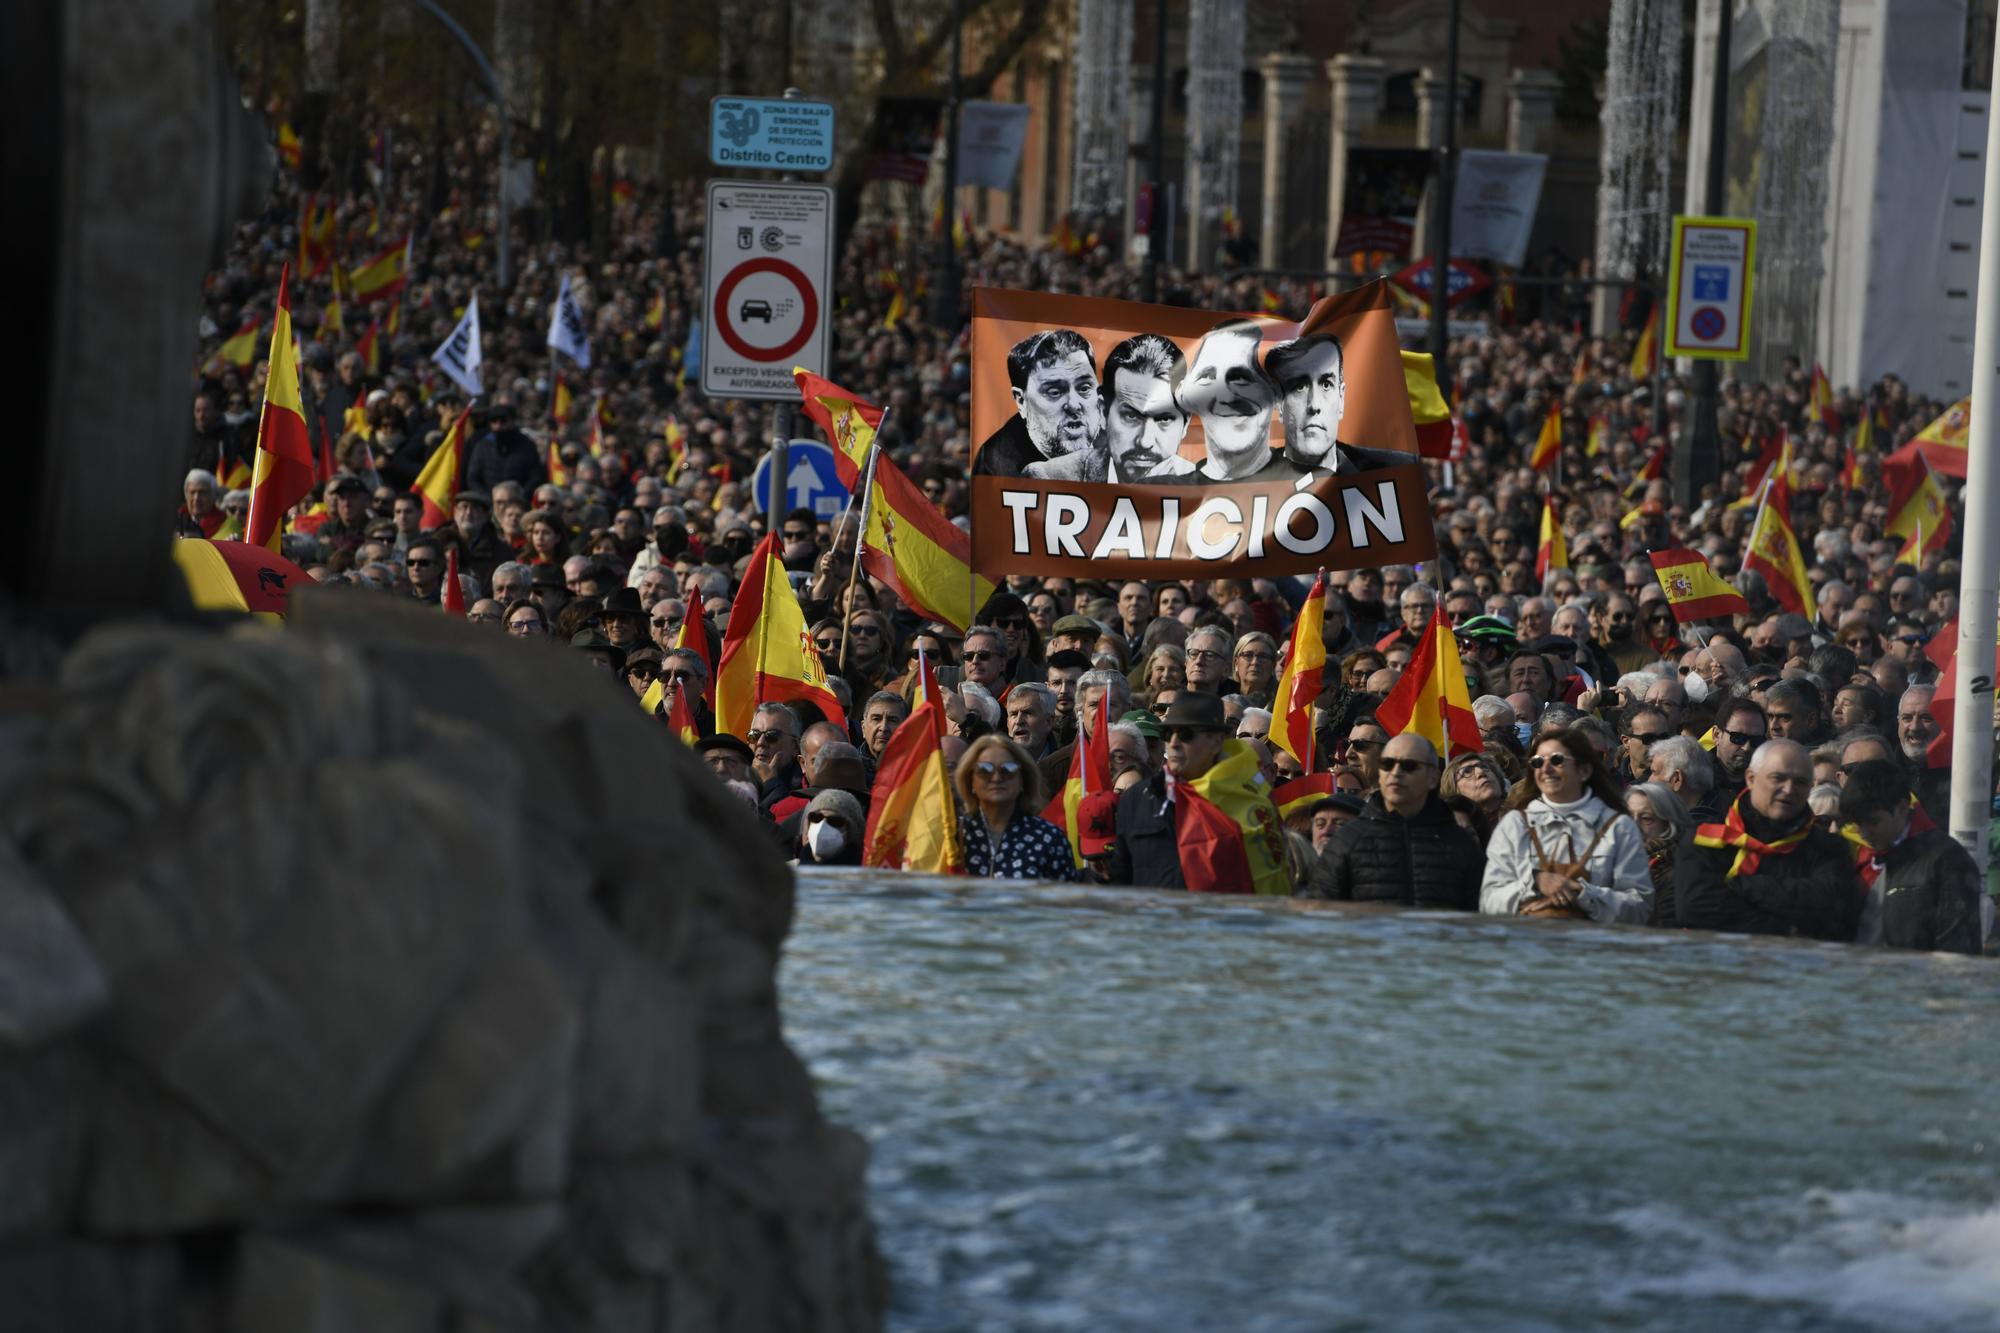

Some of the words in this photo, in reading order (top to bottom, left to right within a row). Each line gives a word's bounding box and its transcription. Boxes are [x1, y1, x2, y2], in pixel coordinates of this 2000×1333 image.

[788, 107, 801, 115] DE
[803, 108, 830, 116] BAJAS
[773, 117, 819, 126] EMISIONES
[768, 127, 780, 135] DE
[783, 127, 823, 136] ESPECIAL
[720, 148, 772, 162] Distrito
[775, 151, 827, 166] Centro
[713, 366, 758, 376] EXCEPTO
[1002, 472, 1407, 561] TRAICIÓN
